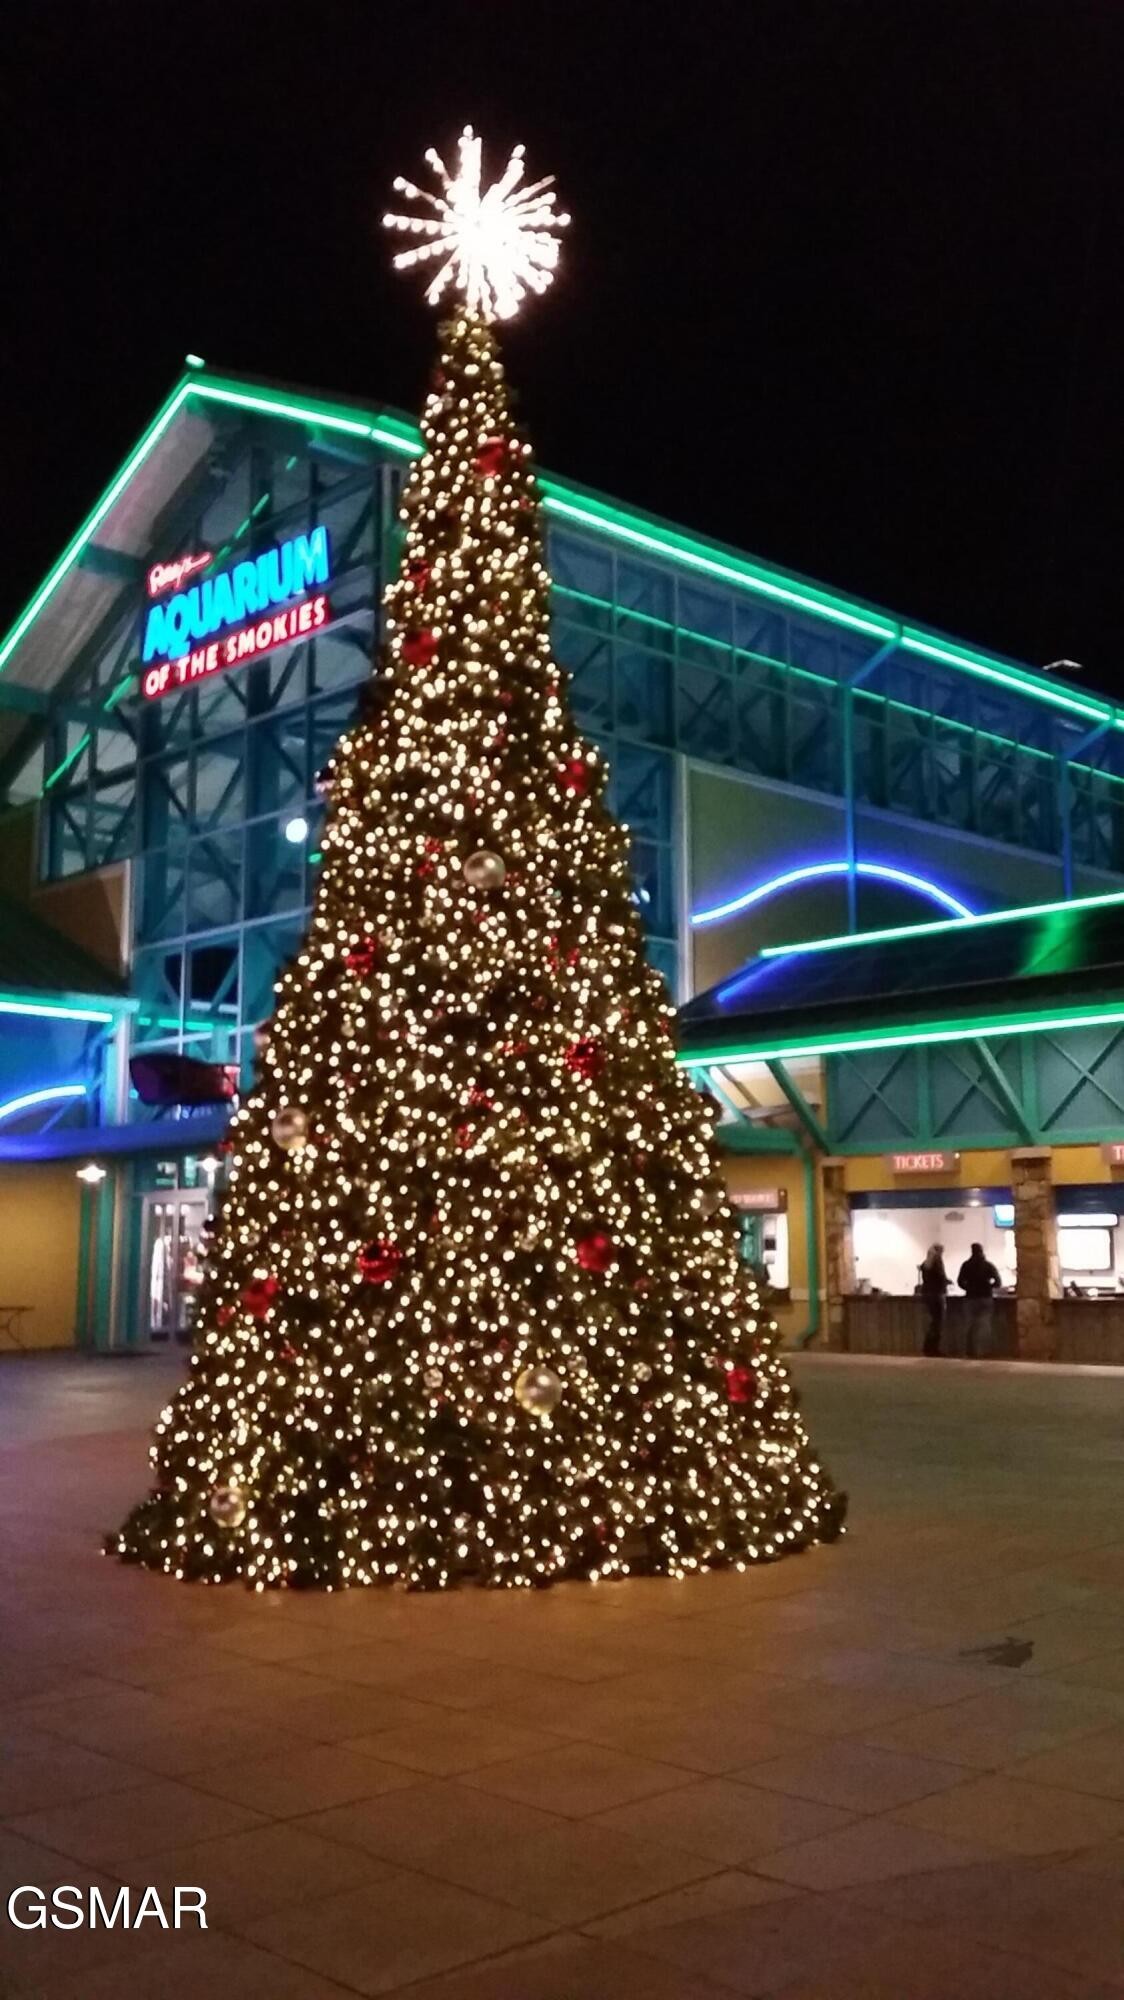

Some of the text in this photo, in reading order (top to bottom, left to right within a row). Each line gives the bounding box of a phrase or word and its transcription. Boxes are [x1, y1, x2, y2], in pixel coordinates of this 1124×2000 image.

[143, 525, 329, 663] AQUARIUM
[145, 596, 326, 696] OF THE SMOKIES
[893, 1153, 944, 1169] TICKETS
